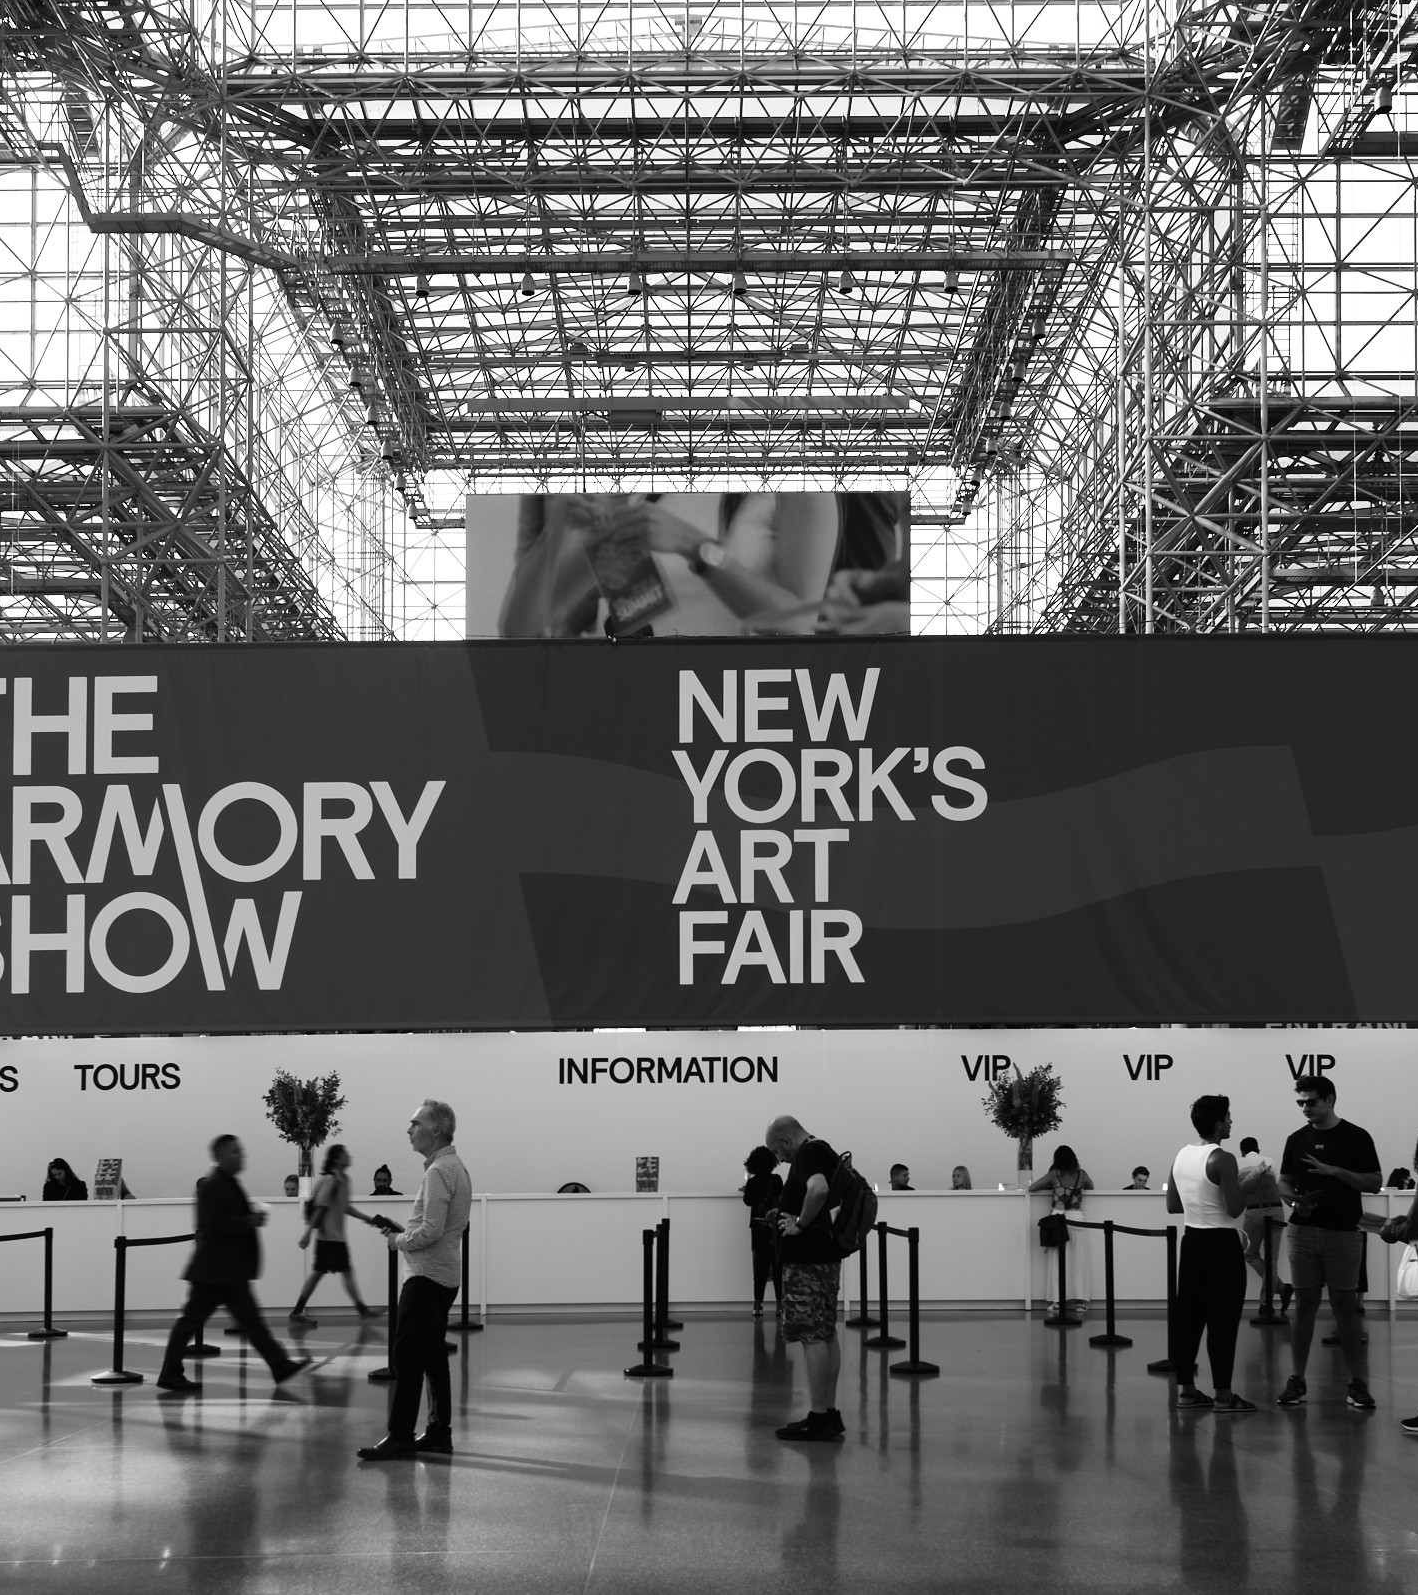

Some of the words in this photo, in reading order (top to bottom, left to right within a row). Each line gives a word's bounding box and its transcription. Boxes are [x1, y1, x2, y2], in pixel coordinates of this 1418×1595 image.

[679, 667, 881, 743] NEW
[671, 746, 988, 824] YORK’S
[671, 828, 850, 905] ART
[679, 909, 866, 985] FAIR
[74, 1062, 181, 1091] TOURS
[558, 1056, 779, 1085] INFORMATION
[960, 1054, 1011, 1081] VIP
[1122, 1054, 1174, 1081] VIP
[1285, 1054, 1336, 1080] VIP
